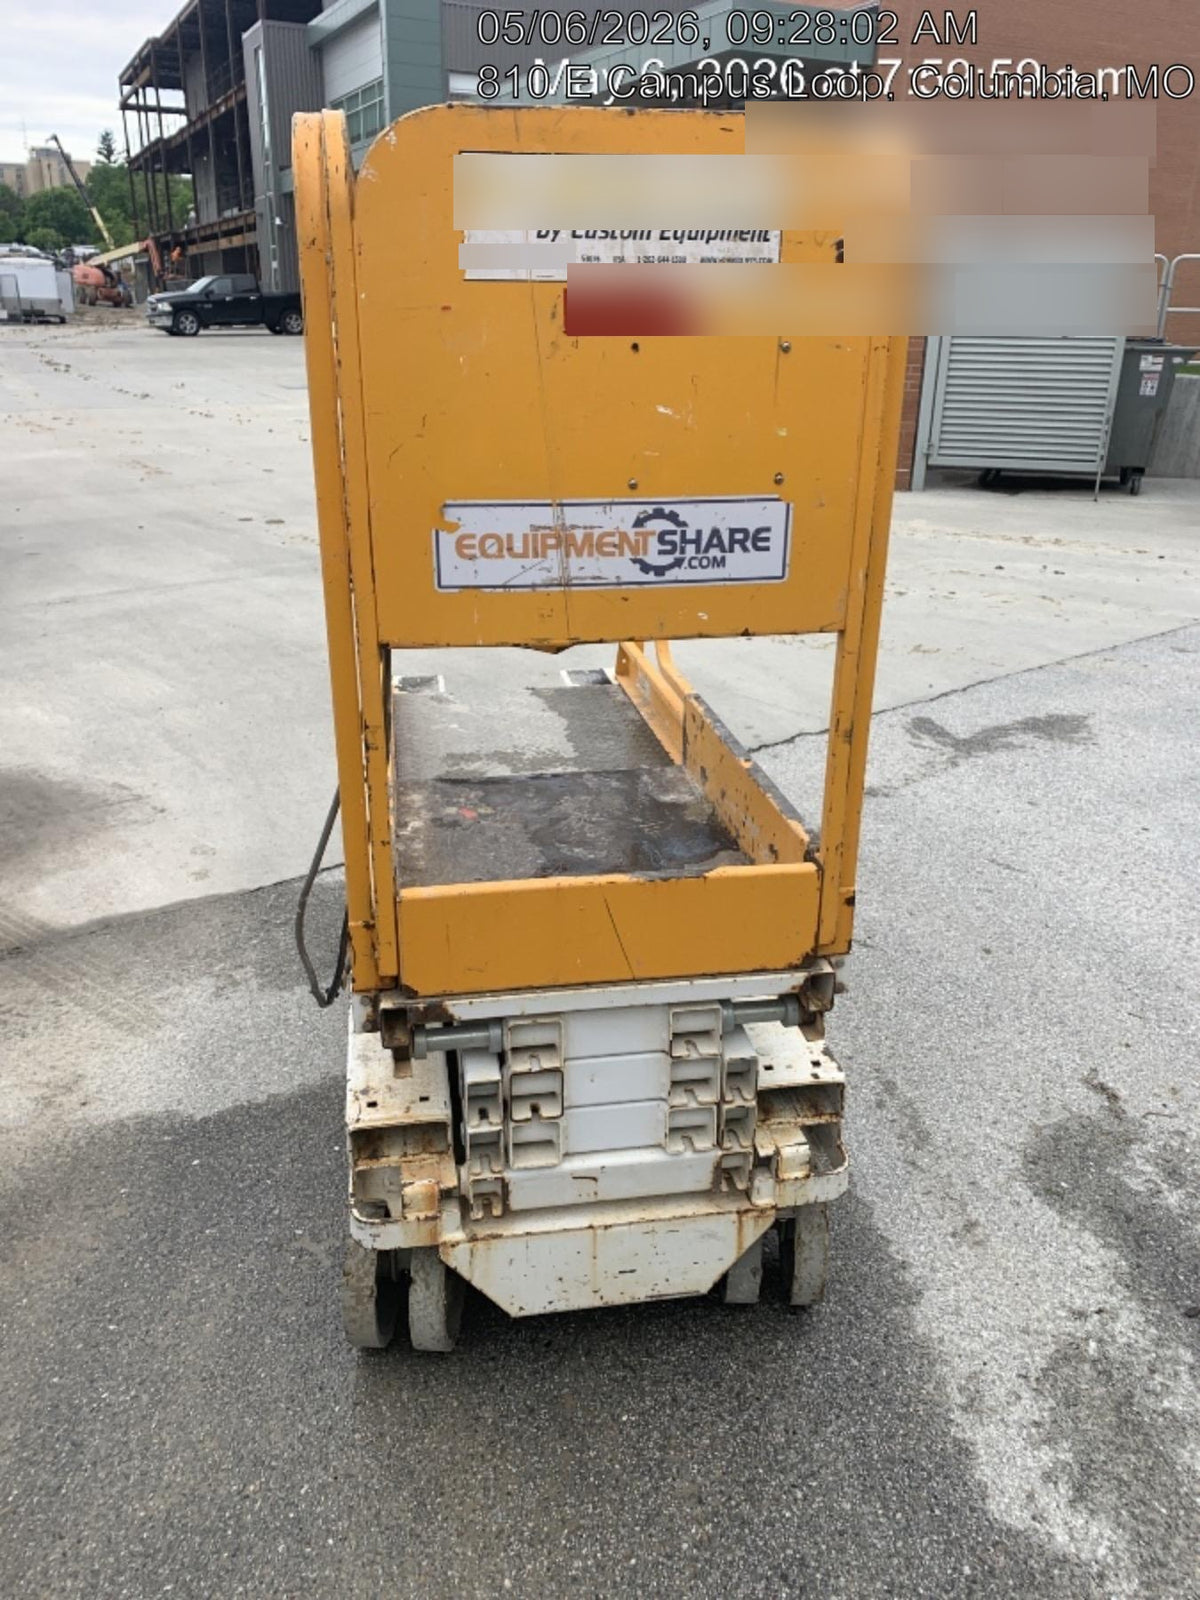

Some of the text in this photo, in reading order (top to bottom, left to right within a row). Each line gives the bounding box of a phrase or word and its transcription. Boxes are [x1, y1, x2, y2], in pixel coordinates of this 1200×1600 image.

[659, 229, 771, 245] Equipment
[454, 526, 772, 561] EQUIPMENTSHARE
[683, 554, 727, 571] .COM
